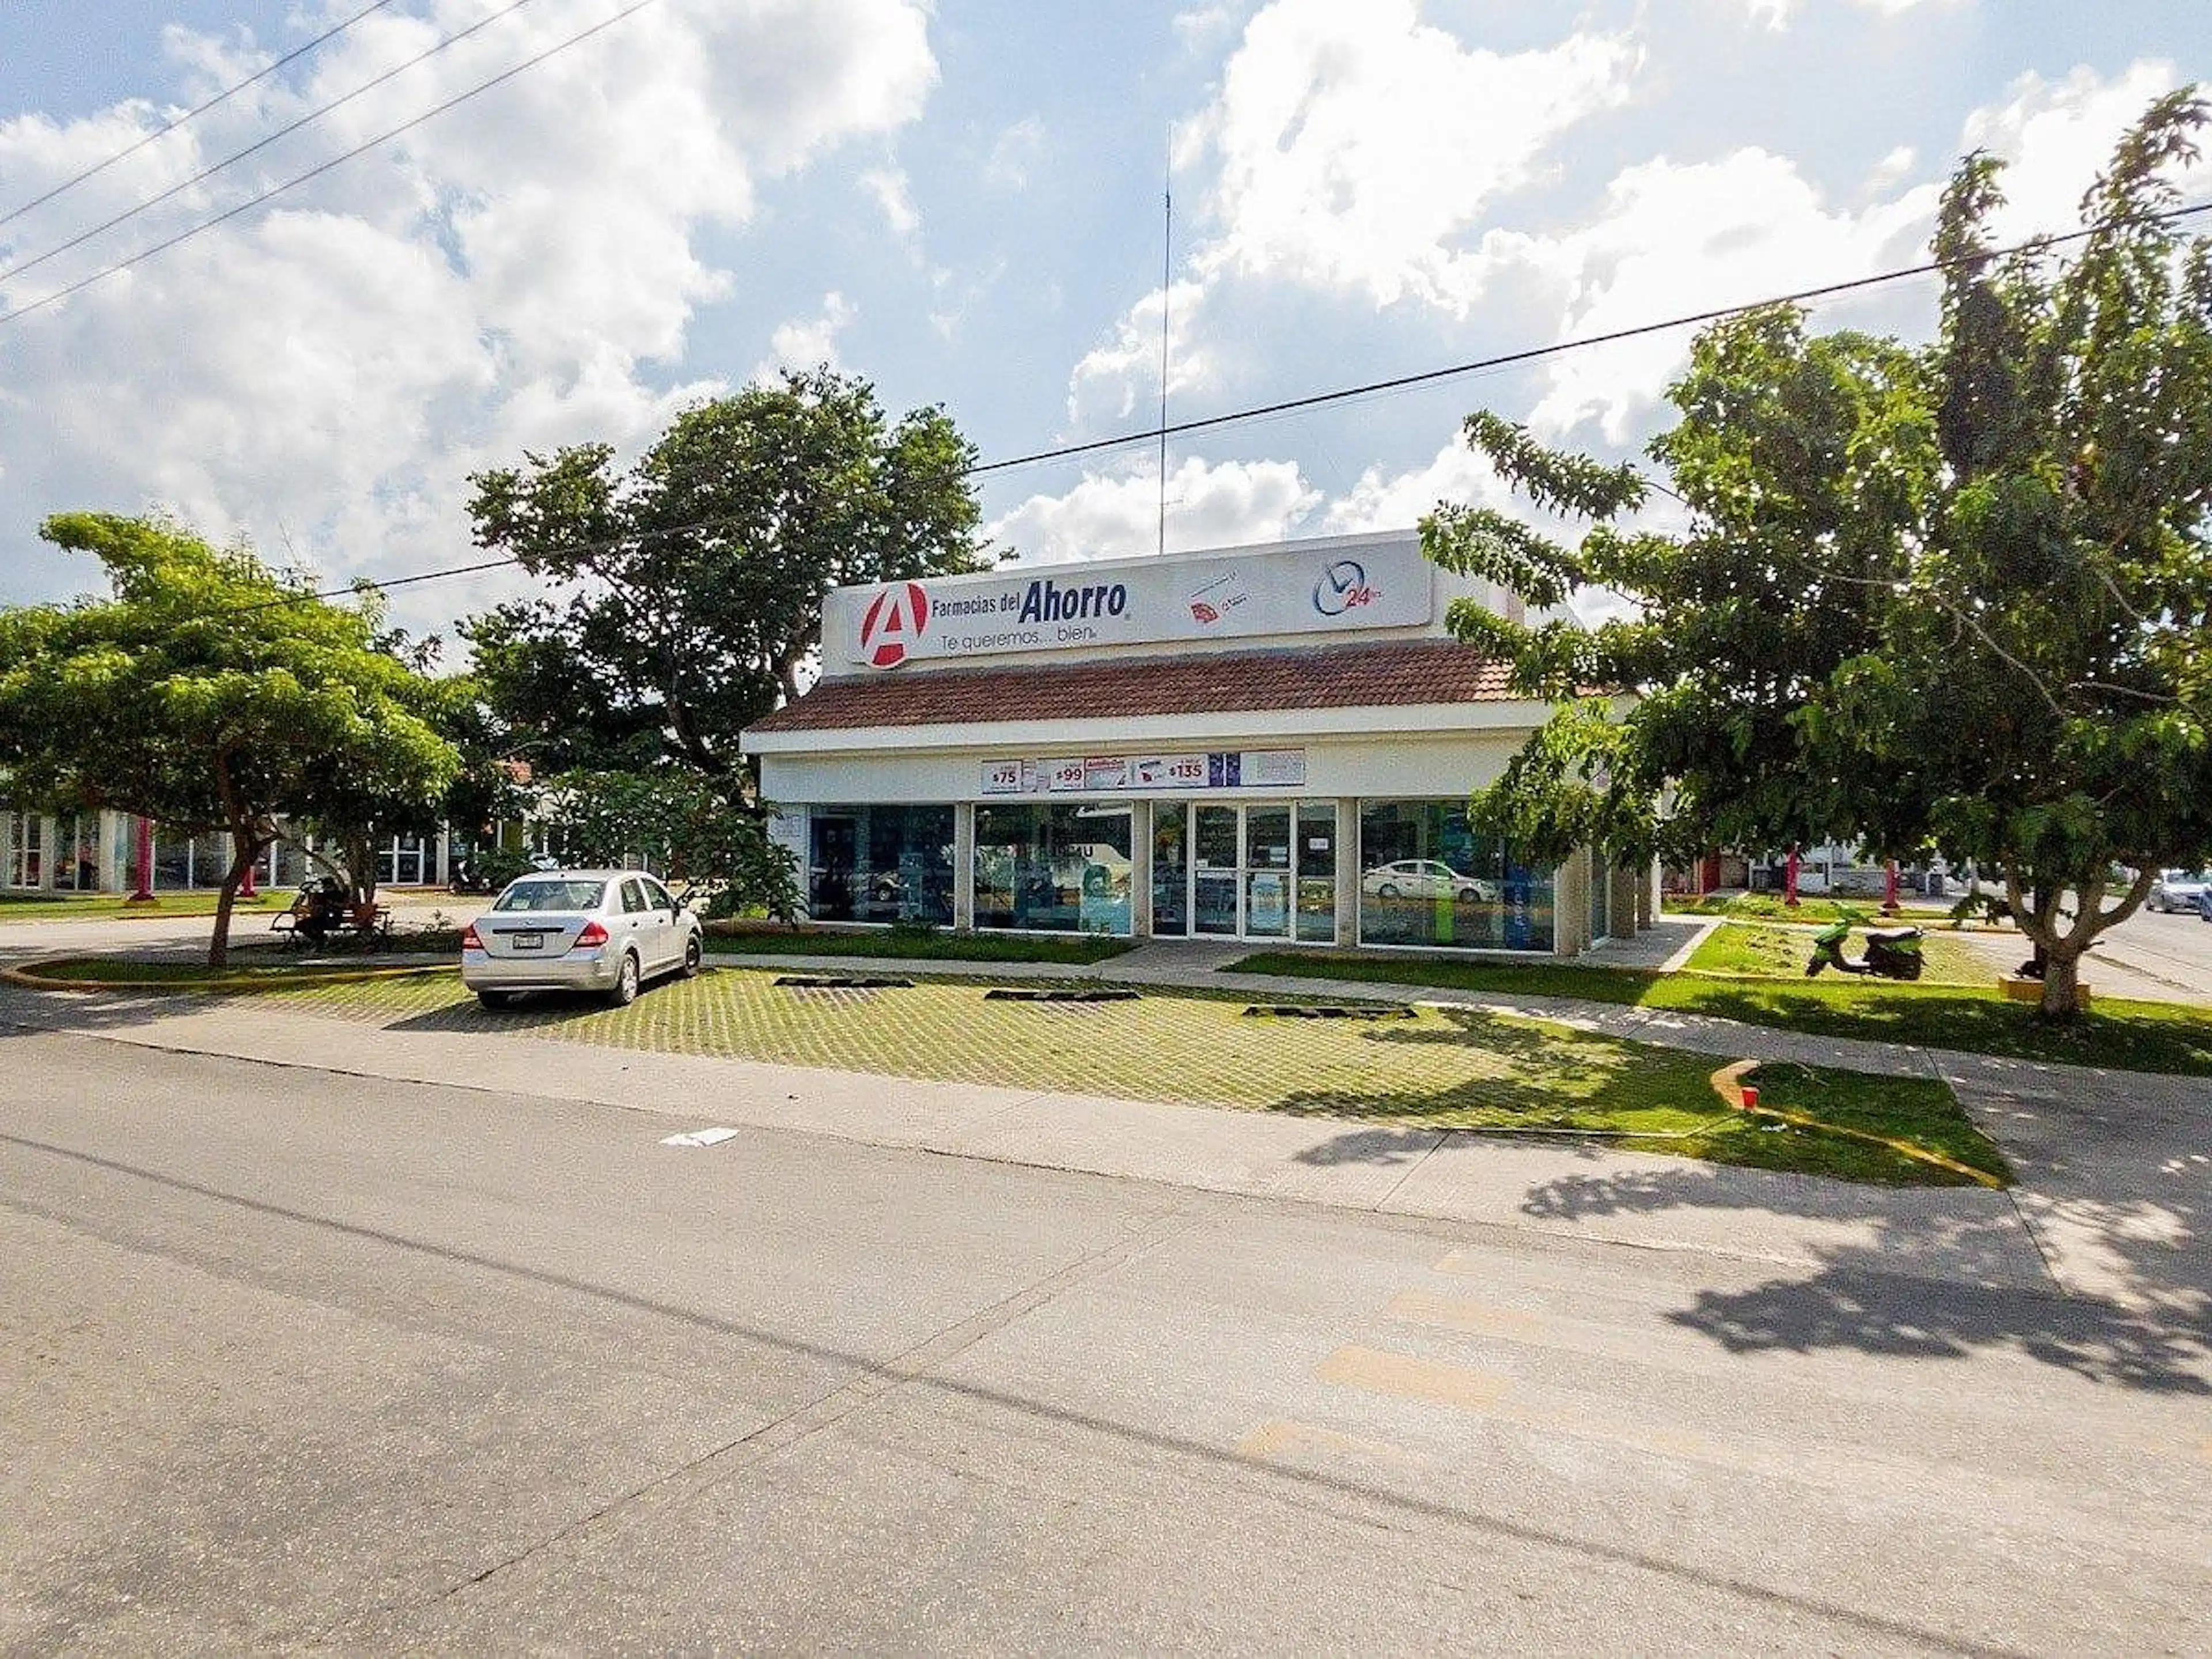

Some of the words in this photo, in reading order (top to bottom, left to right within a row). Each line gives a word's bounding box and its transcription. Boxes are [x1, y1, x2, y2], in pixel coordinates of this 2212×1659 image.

[932, 596, 996, 618] Farmacias
[1001, 591, 1020, 613] del
[1018, 580, 1127, 623] Ahorro
[942, 635, 958, 650] Te
[1169, 764, 1202, 777] $135
